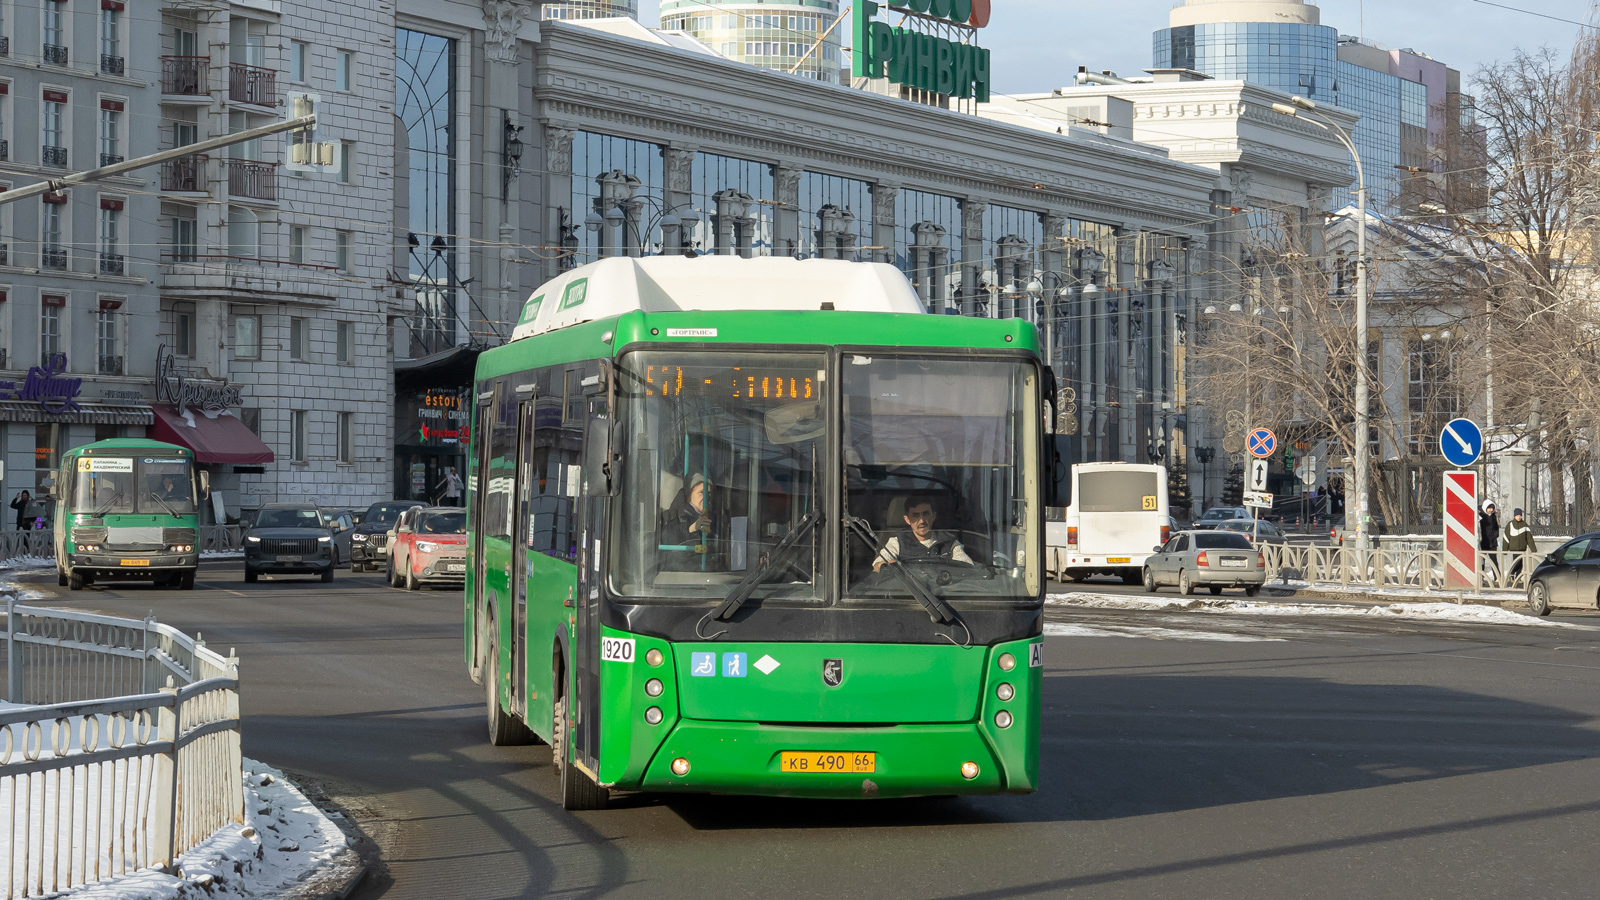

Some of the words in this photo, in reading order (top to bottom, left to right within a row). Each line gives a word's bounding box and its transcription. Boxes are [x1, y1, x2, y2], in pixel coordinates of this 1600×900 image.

[853, 0, 991, 103] ГРИНВИЧ
[1145, 498, 1155, 508] 51
[602, 639, 632, 660] 1920
[816, 755, 845, 770] 490
[854, 754, 869, 766] 66
